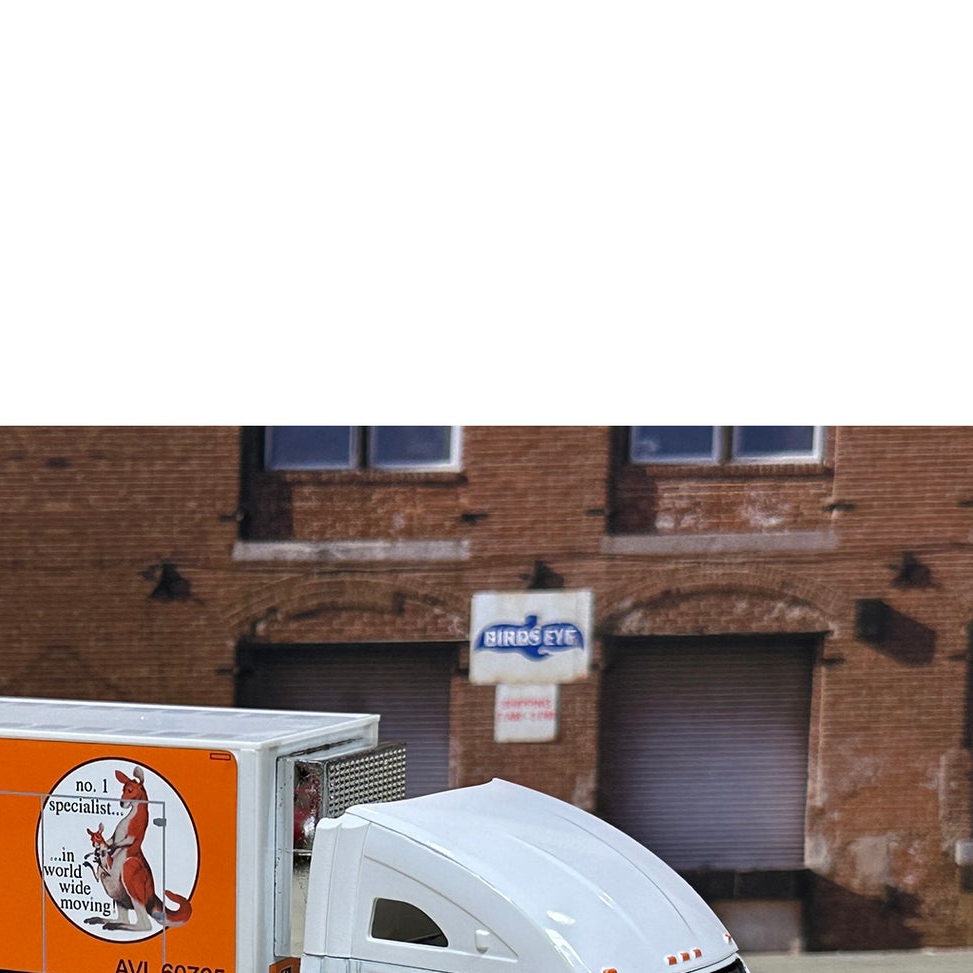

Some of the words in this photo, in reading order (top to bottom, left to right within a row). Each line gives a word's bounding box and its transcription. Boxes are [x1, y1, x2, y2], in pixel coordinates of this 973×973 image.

[544, 630, 577, 646] EYE
[76, 780, 96, 793] no.
[49, 798, 124, 816] specialist...
[44, 864, 82, 878] world
[59, 880, 91, 895] wide
